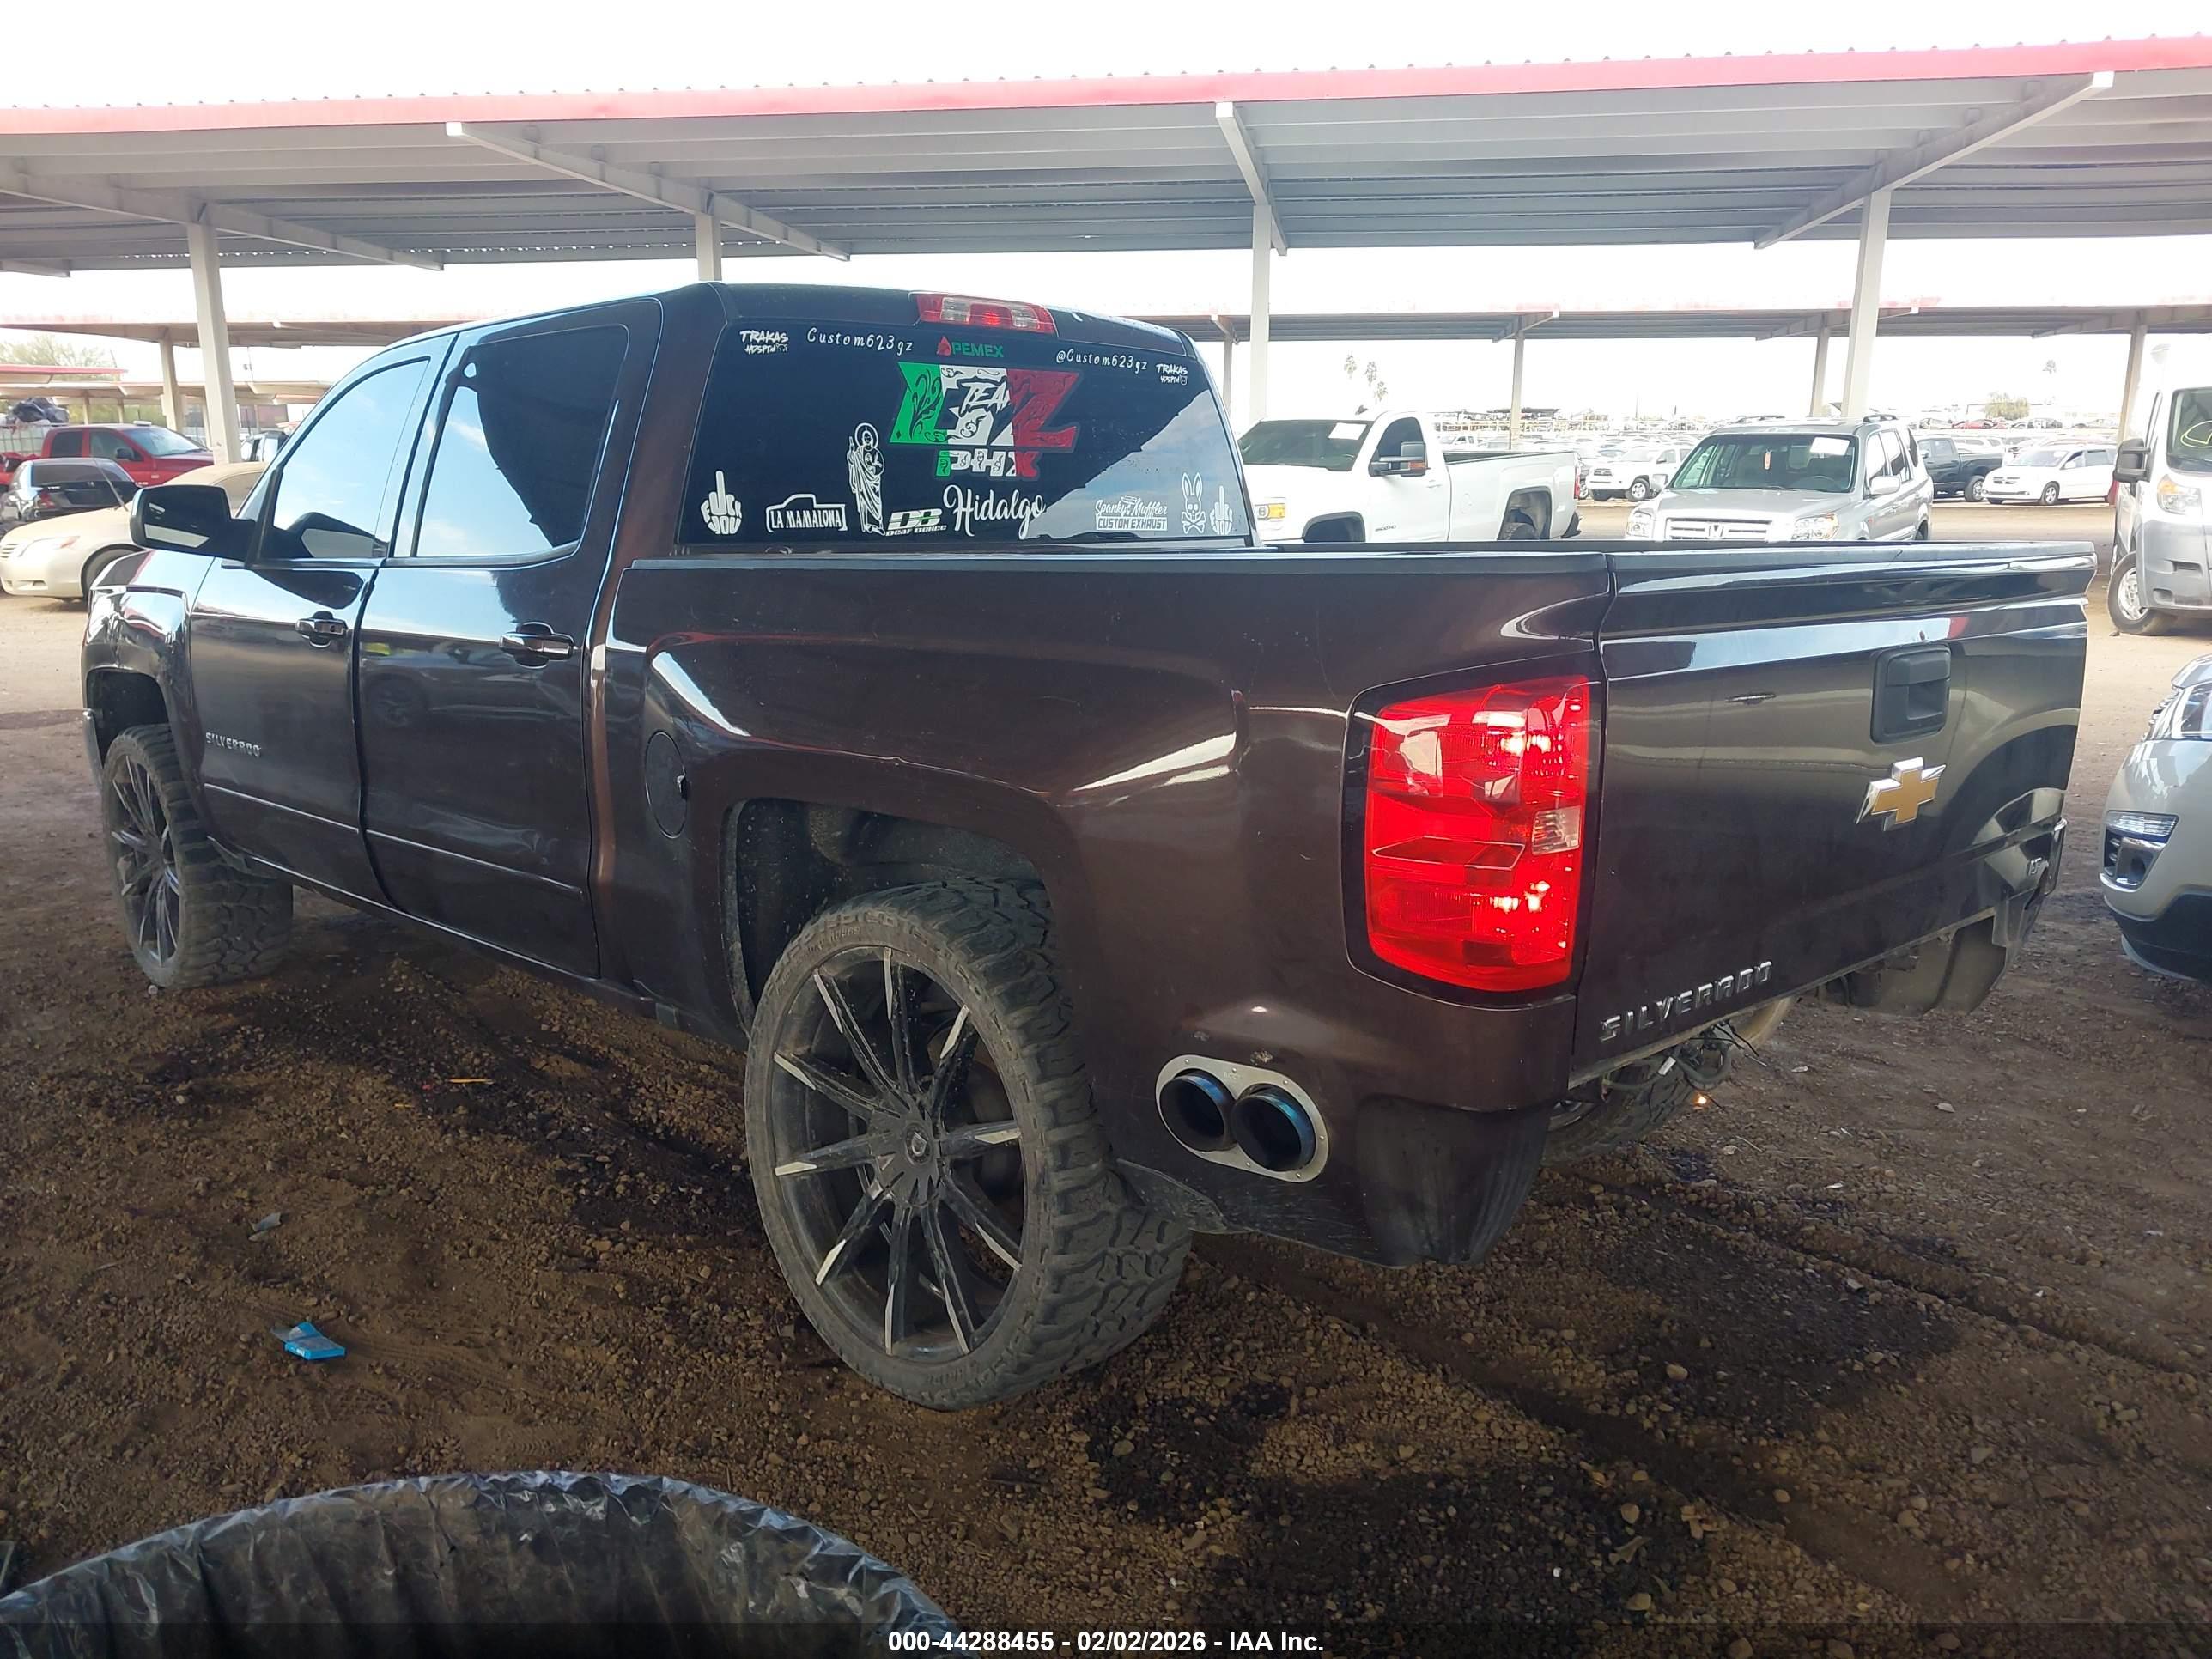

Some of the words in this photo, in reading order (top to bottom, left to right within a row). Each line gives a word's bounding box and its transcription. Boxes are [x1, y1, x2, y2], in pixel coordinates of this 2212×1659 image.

[739, 330, 789, 343] TRAKAS
[807, 327, 914, 356] Custom623gz
[952, 342, 1004, 358] PEMEX
[1056, 349, 1147, 374] @Custom623gz
[1156, 363, 1188, 375] TRAKAS
[770, 510, 784, 528] LA
[786, 509, 842, 529] MAMALONA
[888, 508, 943, 531] DB
[943, 484, 1046, 540] Hidalgo
[1097, 518, 1129, 529] CUSTOM
[1131, 519, 1166, 530] EXHAUST
[1600, 961, 1772, 1042] SILVERADO
